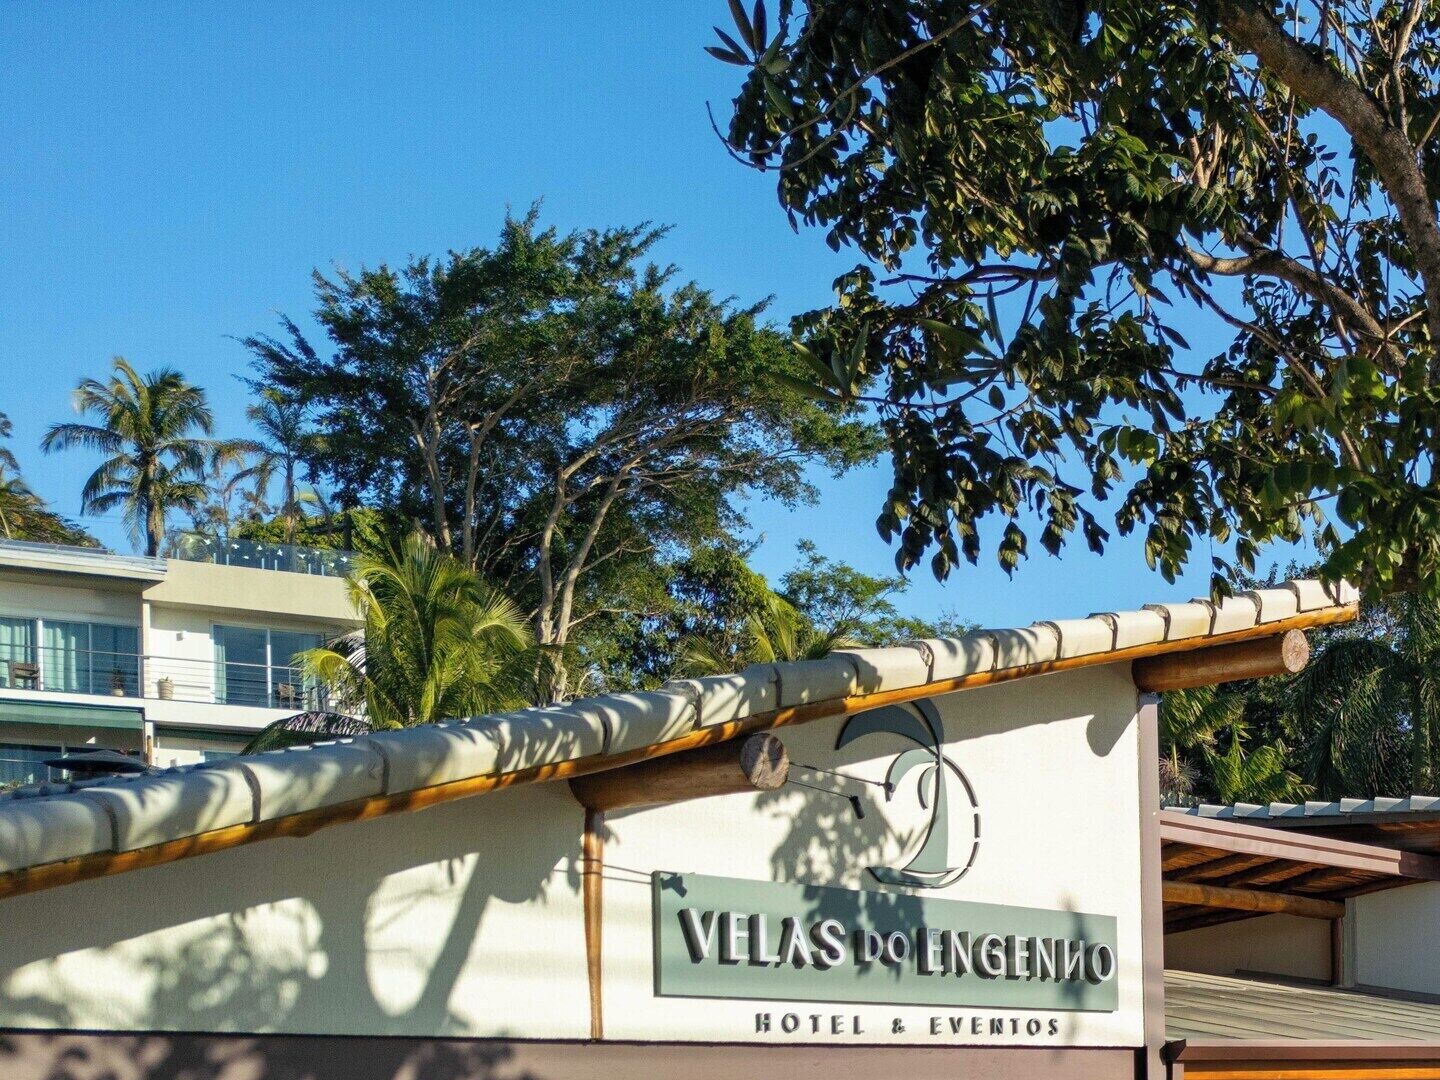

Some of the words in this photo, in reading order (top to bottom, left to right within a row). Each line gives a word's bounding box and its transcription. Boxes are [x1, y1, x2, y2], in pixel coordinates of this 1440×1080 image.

[679, 907, 847, 971] VELAS
[856, 928, 911, 964] DO
[755, 1012, 865, 1035] HOTEL
[891, 1017, 906, 1035] &
[930, 1016, 1060, 1037] EVENTOS
